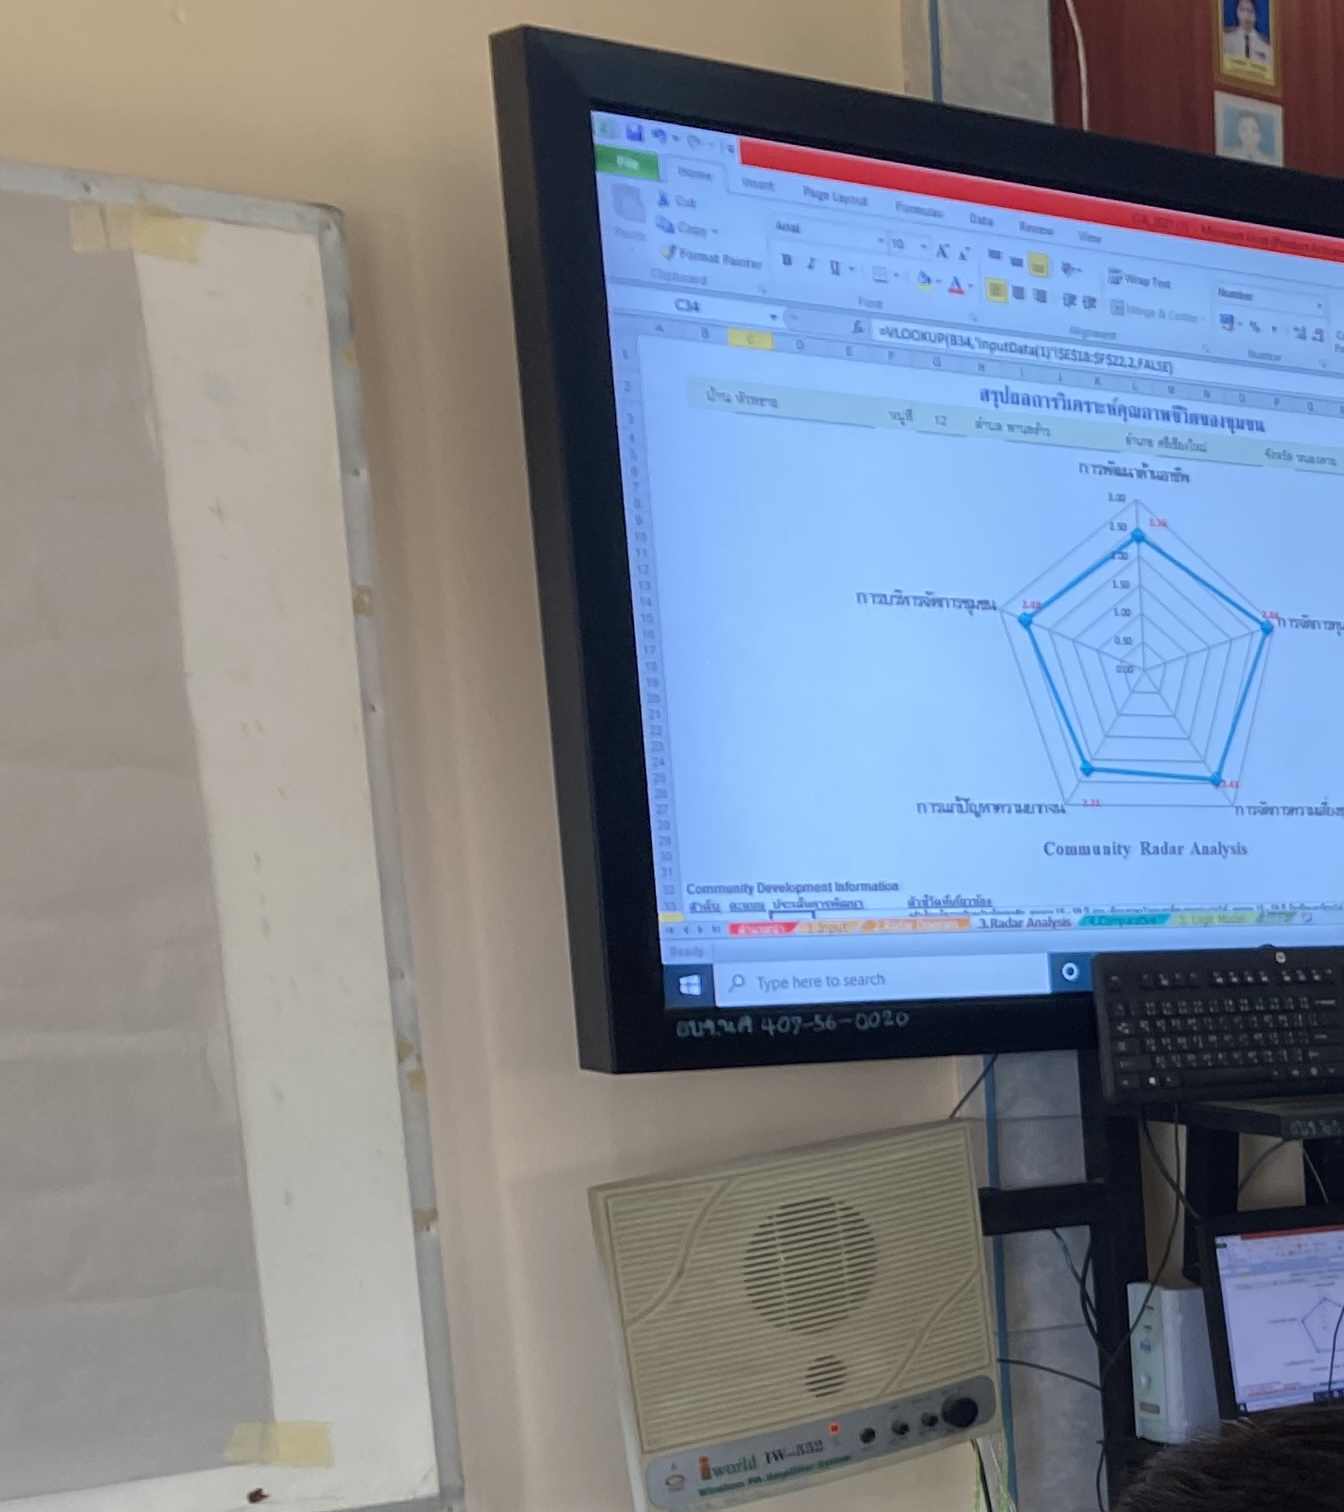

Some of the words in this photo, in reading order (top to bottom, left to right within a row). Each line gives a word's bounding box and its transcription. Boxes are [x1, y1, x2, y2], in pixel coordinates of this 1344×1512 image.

[969, 212, 994, 227] Data
[1042, 839, 1131, 859] Community
[1139, 841, 1185, 856] Radar
[1190, 841, 1248, 859] Analysis
[686, 882, 753, 897] Community
[757, 881, 832, 896] Development
[834, 880, 899, 893] Information
[1026, 916, 1072, 930] Analysis
[757, 976, 789, 992] Type
[792, 975, 822, 989] here
[826, 975, 840, 988] to
[843, 973, 886, 988] search
